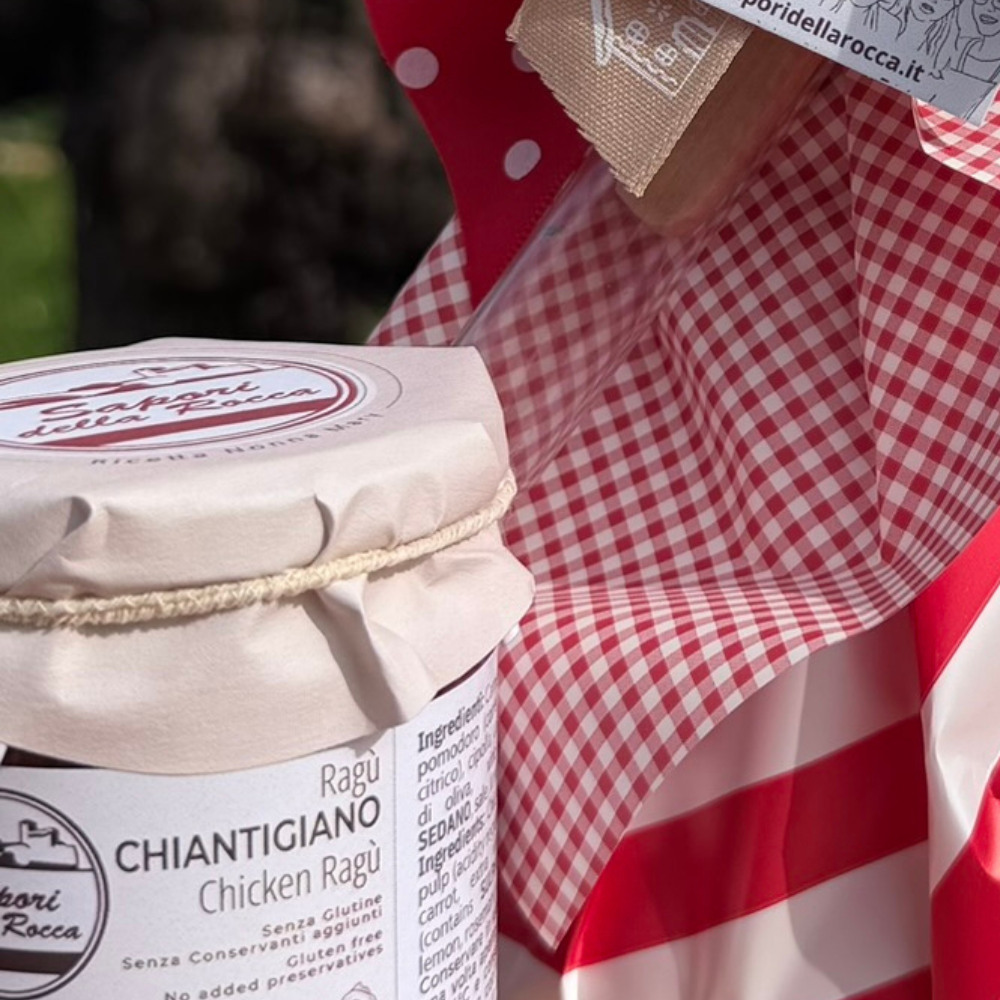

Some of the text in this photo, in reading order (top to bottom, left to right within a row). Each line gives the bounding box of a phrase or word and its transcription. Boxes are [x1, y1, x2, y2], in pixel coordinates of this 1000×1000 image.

[18, 386, 322, 438] della Rocca
[39, 381, 260, 422] Sapori
[320, 748, 381, 799] Ragù
[115, 795, 381, 874] CHIANTIGIANO
[417, 803, 433, 827] di
[0, 886, 61, 912] pori
[199, 838, 381, 915] Chicken Ragù
[418, 868, 450, 907] pulp
[2, 912, 83, 939] Rocca
[262, 893, 383, 938] Senza Glutine
[121, 906, 383, 971] Senza Conservanti aggiunti
[286, 929, 383, 969] Gluten free
[199, 979, 260, 1000] added
[267, 944, 384, 991] preservatives
